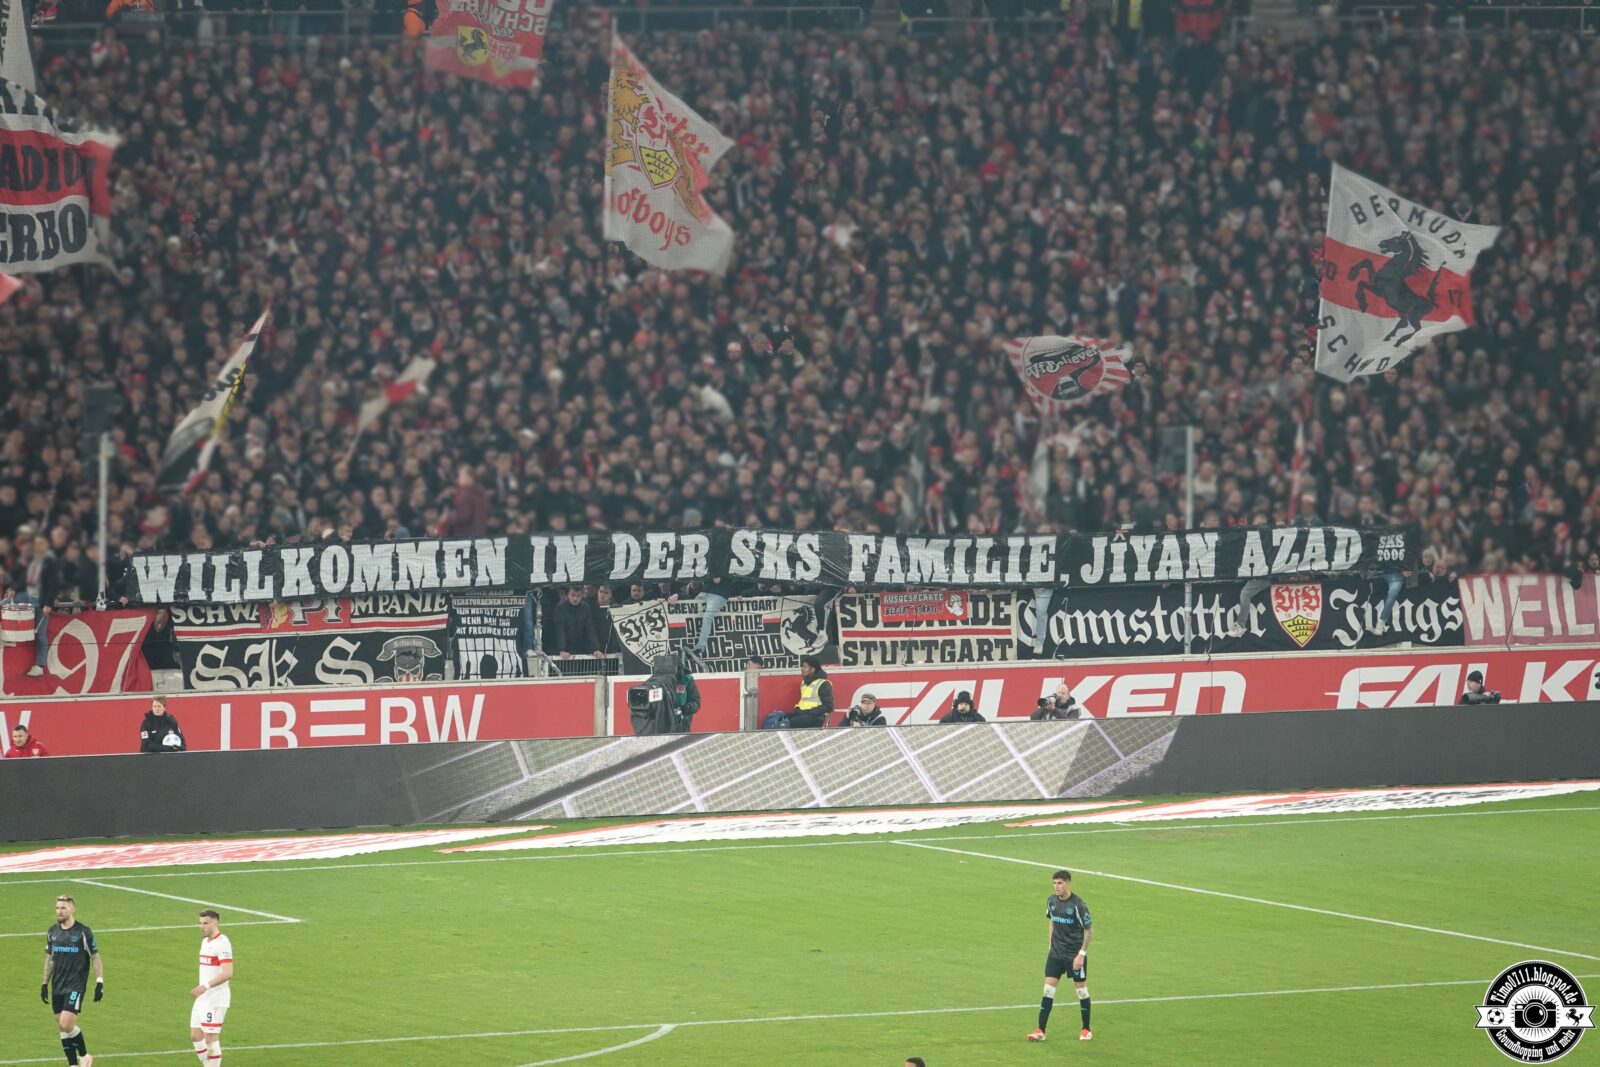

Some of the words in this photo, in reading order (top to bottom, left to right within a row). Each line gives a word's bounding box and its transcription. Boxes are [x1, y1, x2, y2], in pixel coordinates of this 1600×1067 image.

[133, 537, 508, 604] WILLKOMMEN
[530, 535, 588, 584] IN
[609, 532, 710, 580] DER
[729, 530, 822, 581] SKS
[848, 534, 1070, 587] FAMILIE,
[1238, 526, 1363, 578] AZAD
[668, 602, 699, 615] CREW
[1458, 574, 1600, 641] WEIL
[842, 638, 1014, 667] STUTTGART
[834, 670, 1247, 726] FALKEN
[206, 1012, 213, 1023] 9
